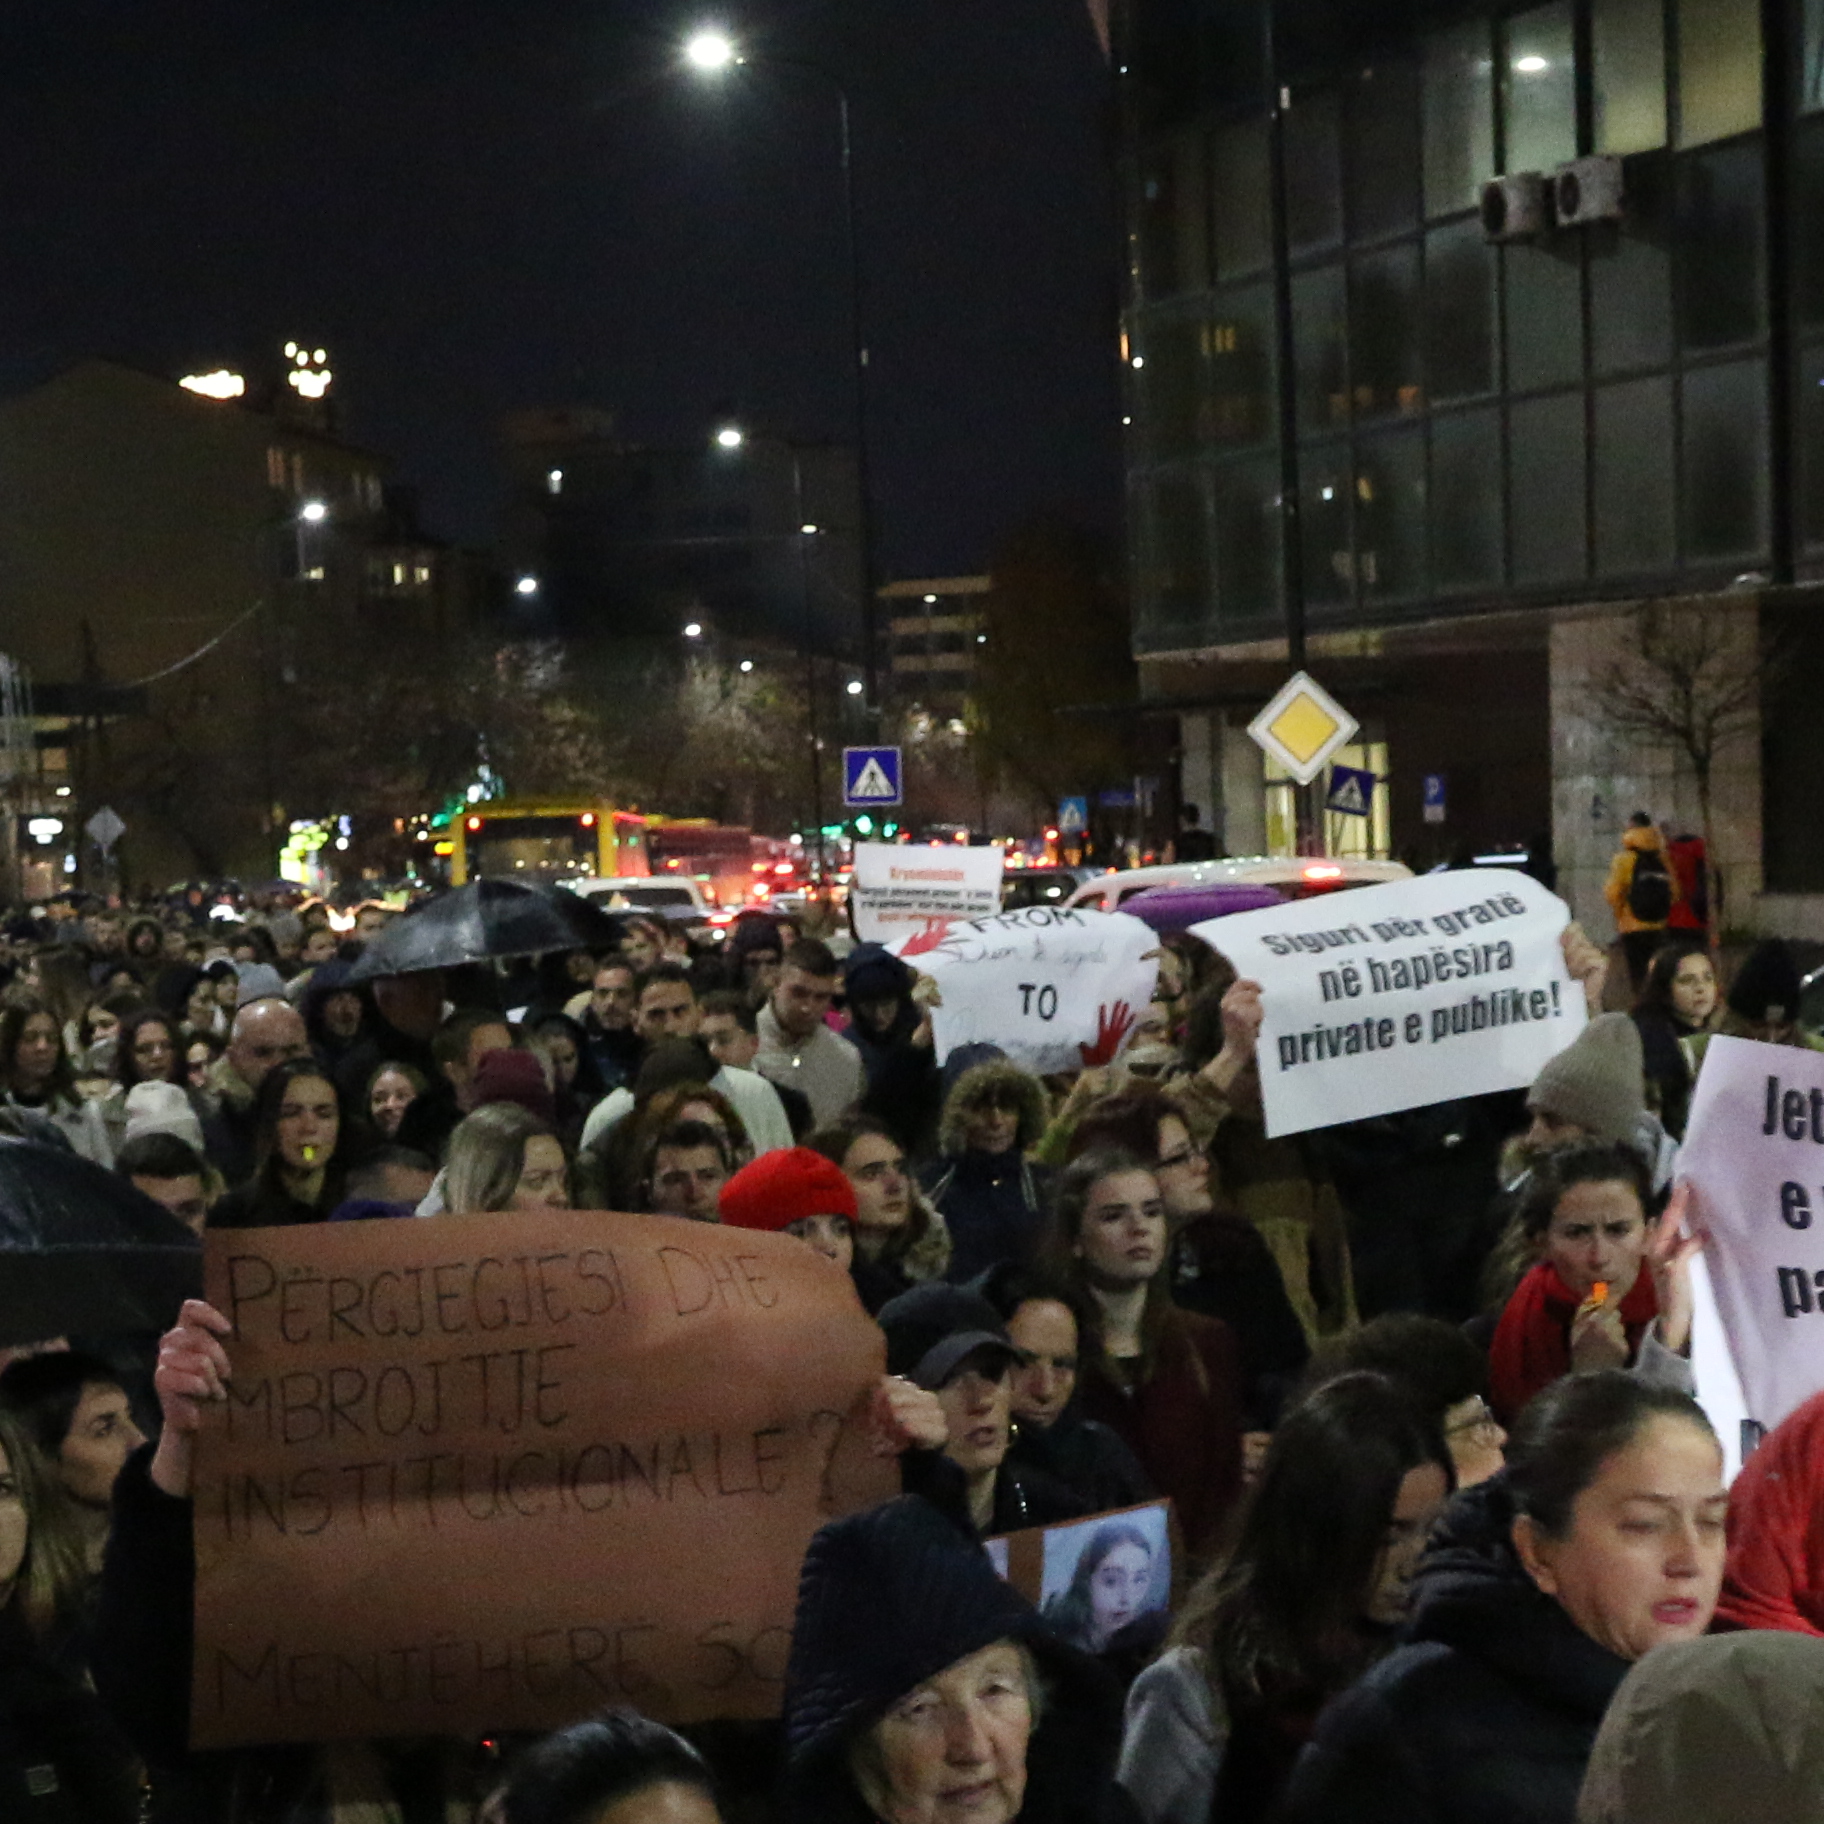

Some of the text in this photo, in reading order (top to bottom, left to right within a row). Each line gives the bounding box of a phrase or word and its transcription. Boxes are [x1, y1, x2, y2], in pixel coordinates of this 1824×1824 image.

[969, 907, 1086, 933] FROM
[1260, 891, 1528, 956] Siguri për gratë
[1018, 983, 1058, 1021] TO
[1319, 939, 1515, 1003] në hapësira
[1277, 979, 1563, 1072] private e publike!
[1780, 1180, 1812, 1231] e
[657, 1246, 779, 1317] DHE
